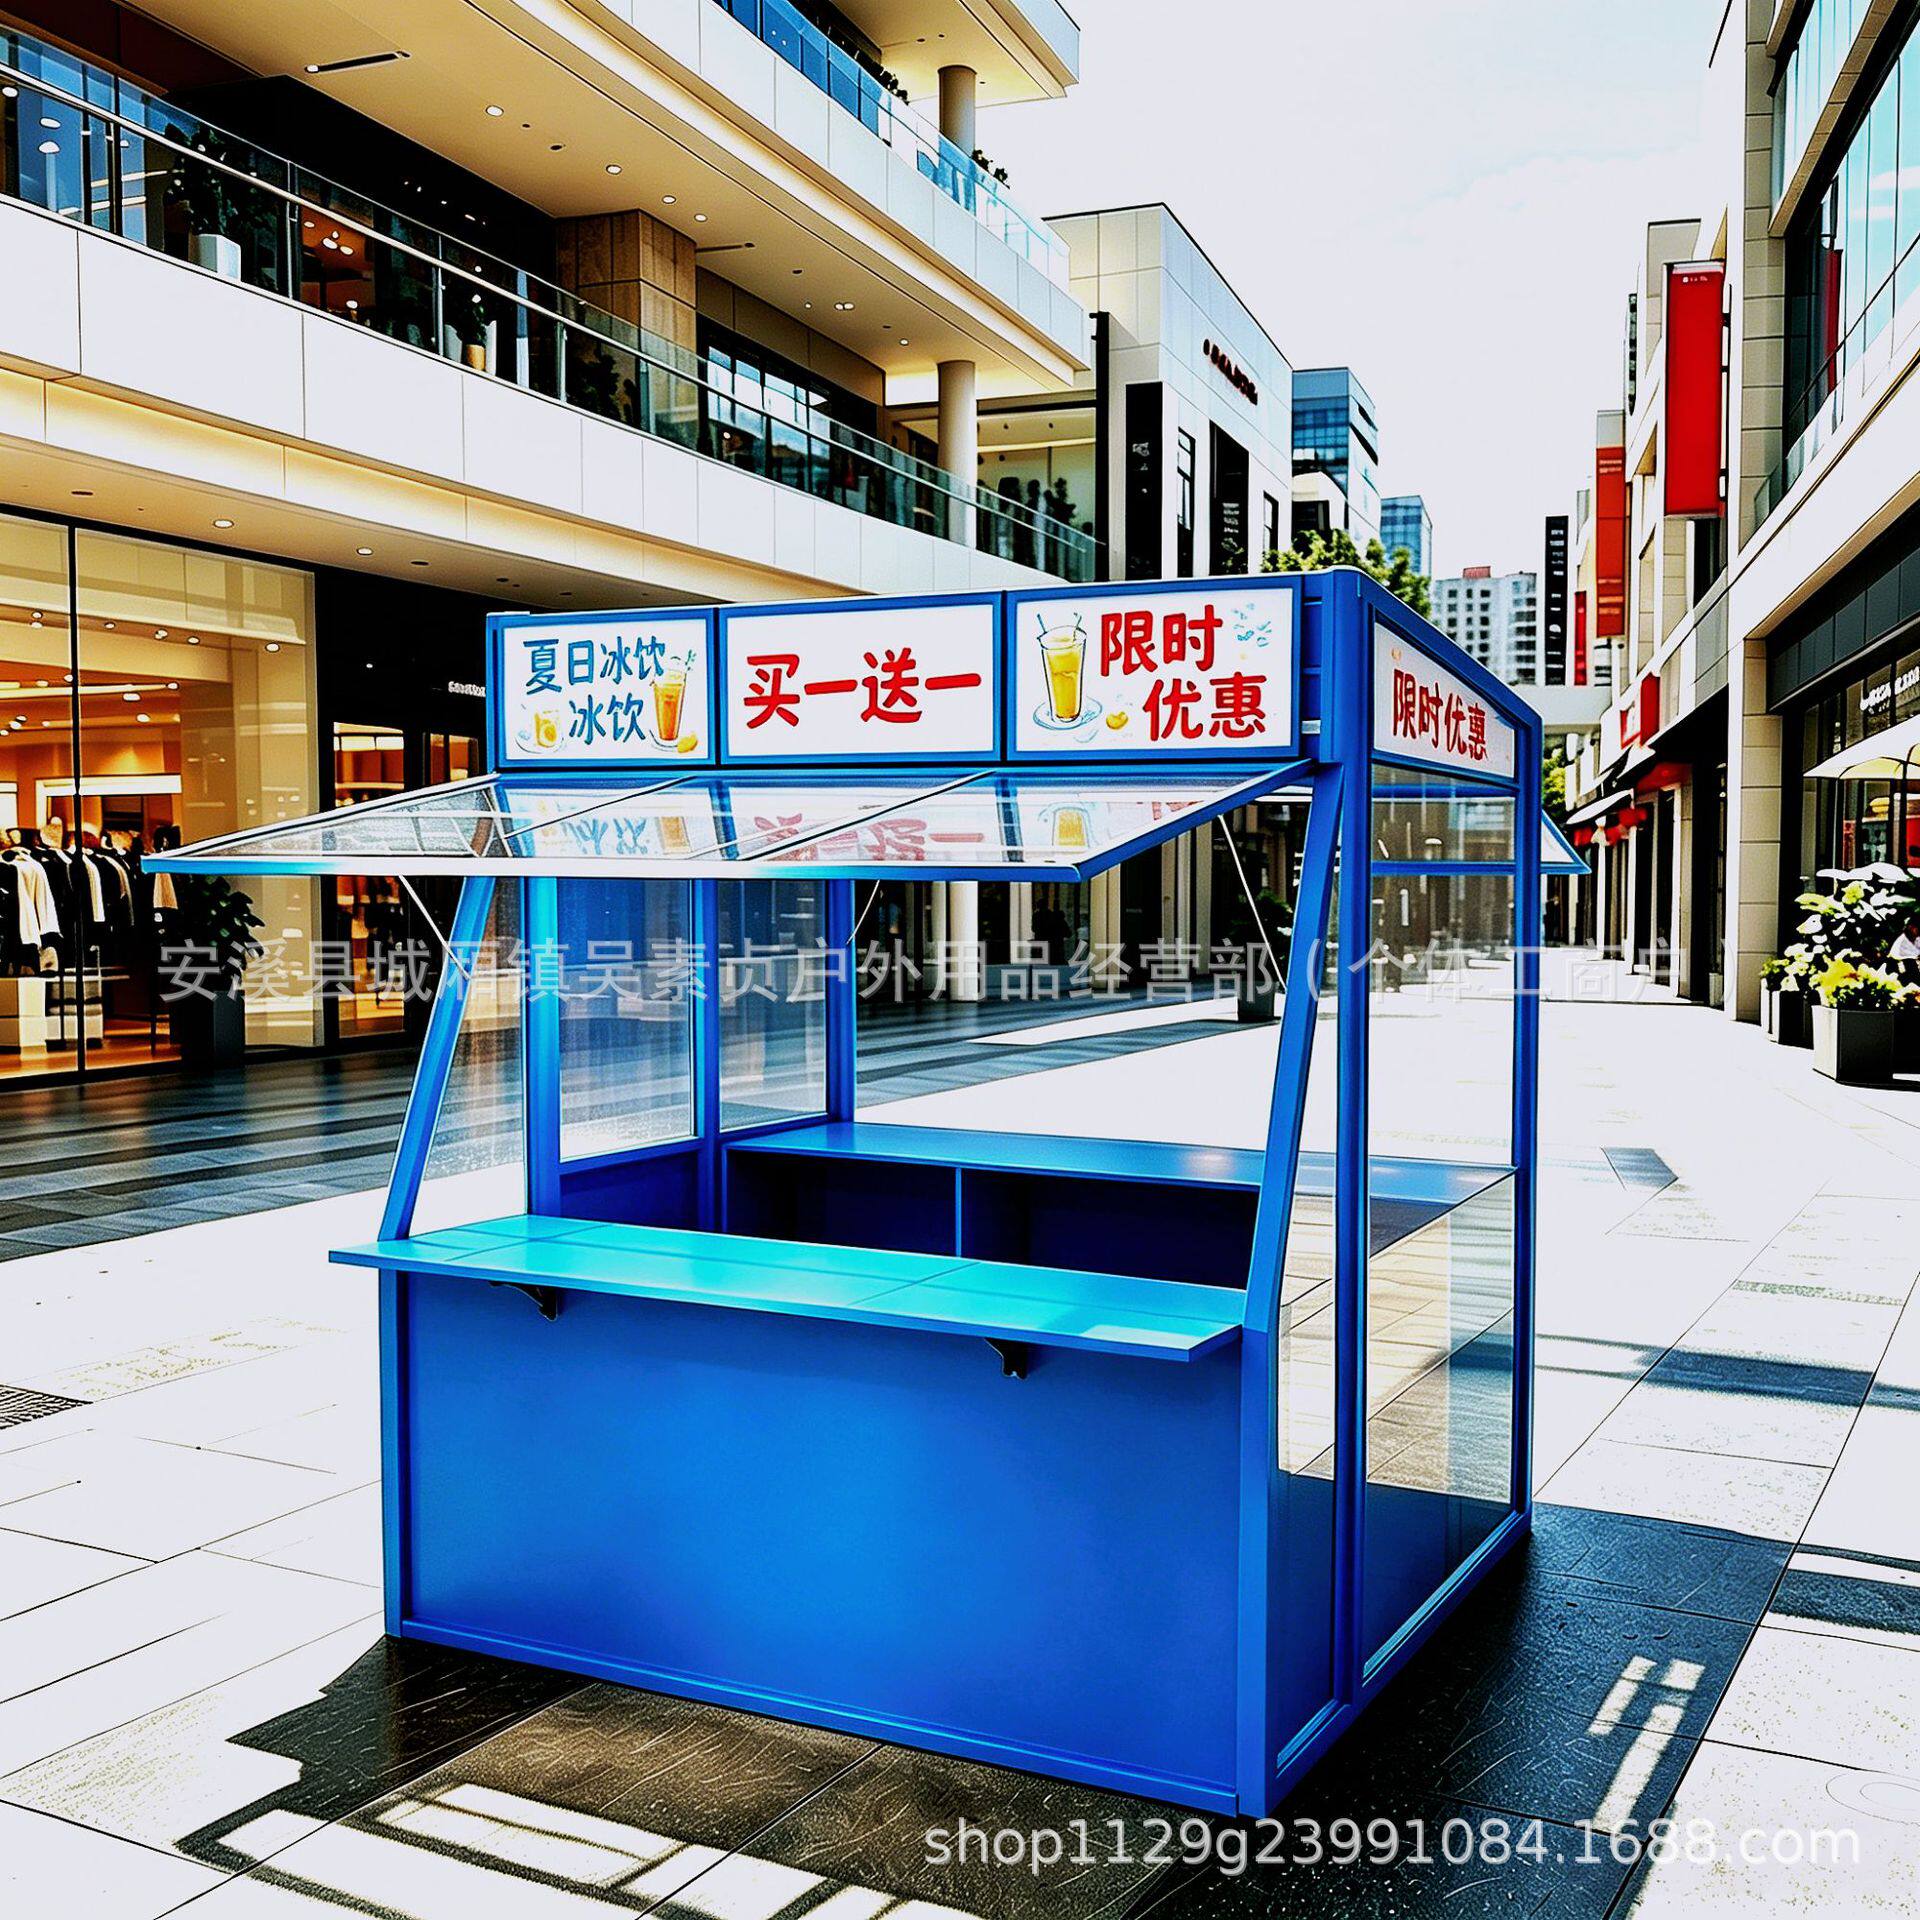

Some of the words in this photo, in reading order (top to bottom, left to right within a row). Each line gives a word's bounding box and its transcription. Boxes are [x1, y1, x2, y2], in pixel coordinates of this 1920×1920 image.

[523, 635, 666, 695] 夏日冰饮
[1101, 603, 1224, 677] 限时
[569, 692, 647, 745] 冰饮
[744, 647, 981, 730] 买一送一
[1142, 671, 1268, 741] 优惠
[1393, 668, 1489, 761] 限时优惠
